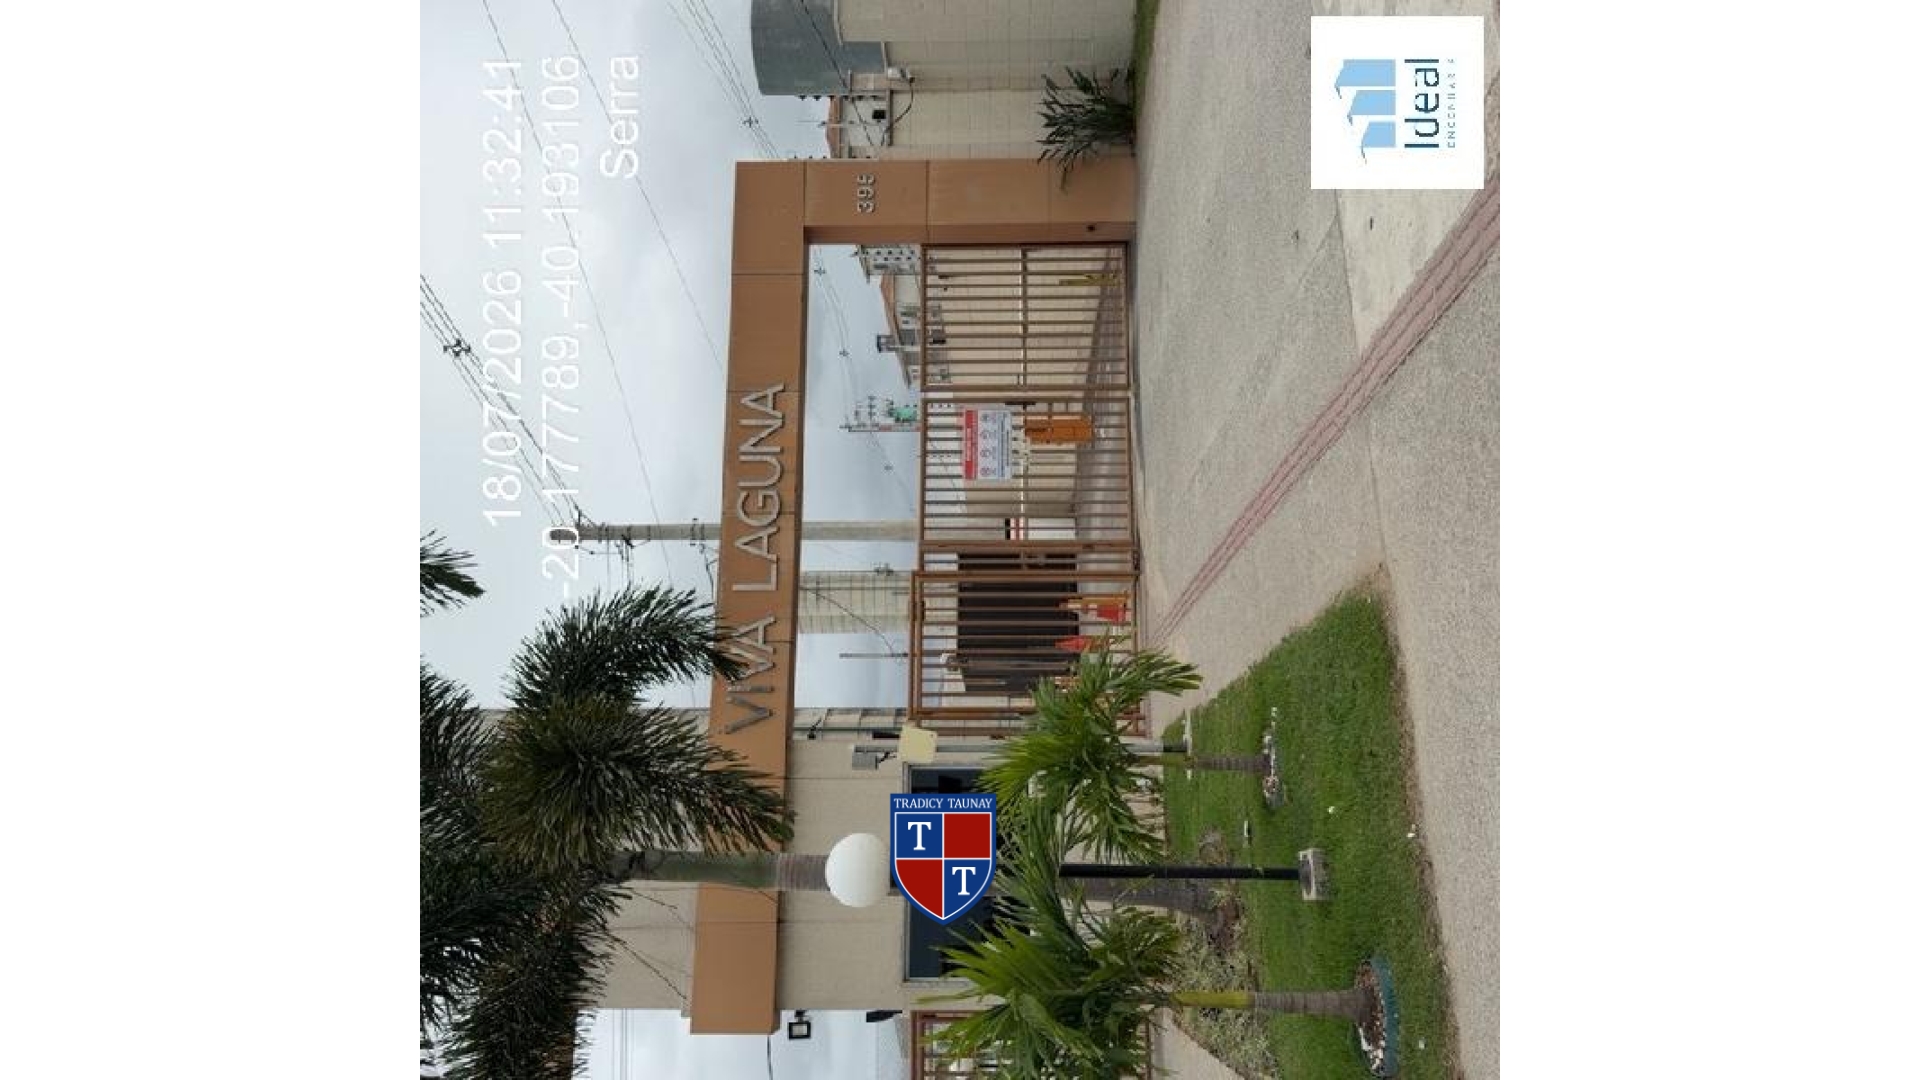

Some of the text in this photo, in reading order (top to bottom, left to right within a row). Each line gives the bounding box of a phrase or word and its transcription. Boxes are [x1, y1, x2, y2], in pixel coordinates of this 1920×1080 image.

[856, 174, 875, 213] 395
[720, 383, 785, 734] VIVA LAGUNA
